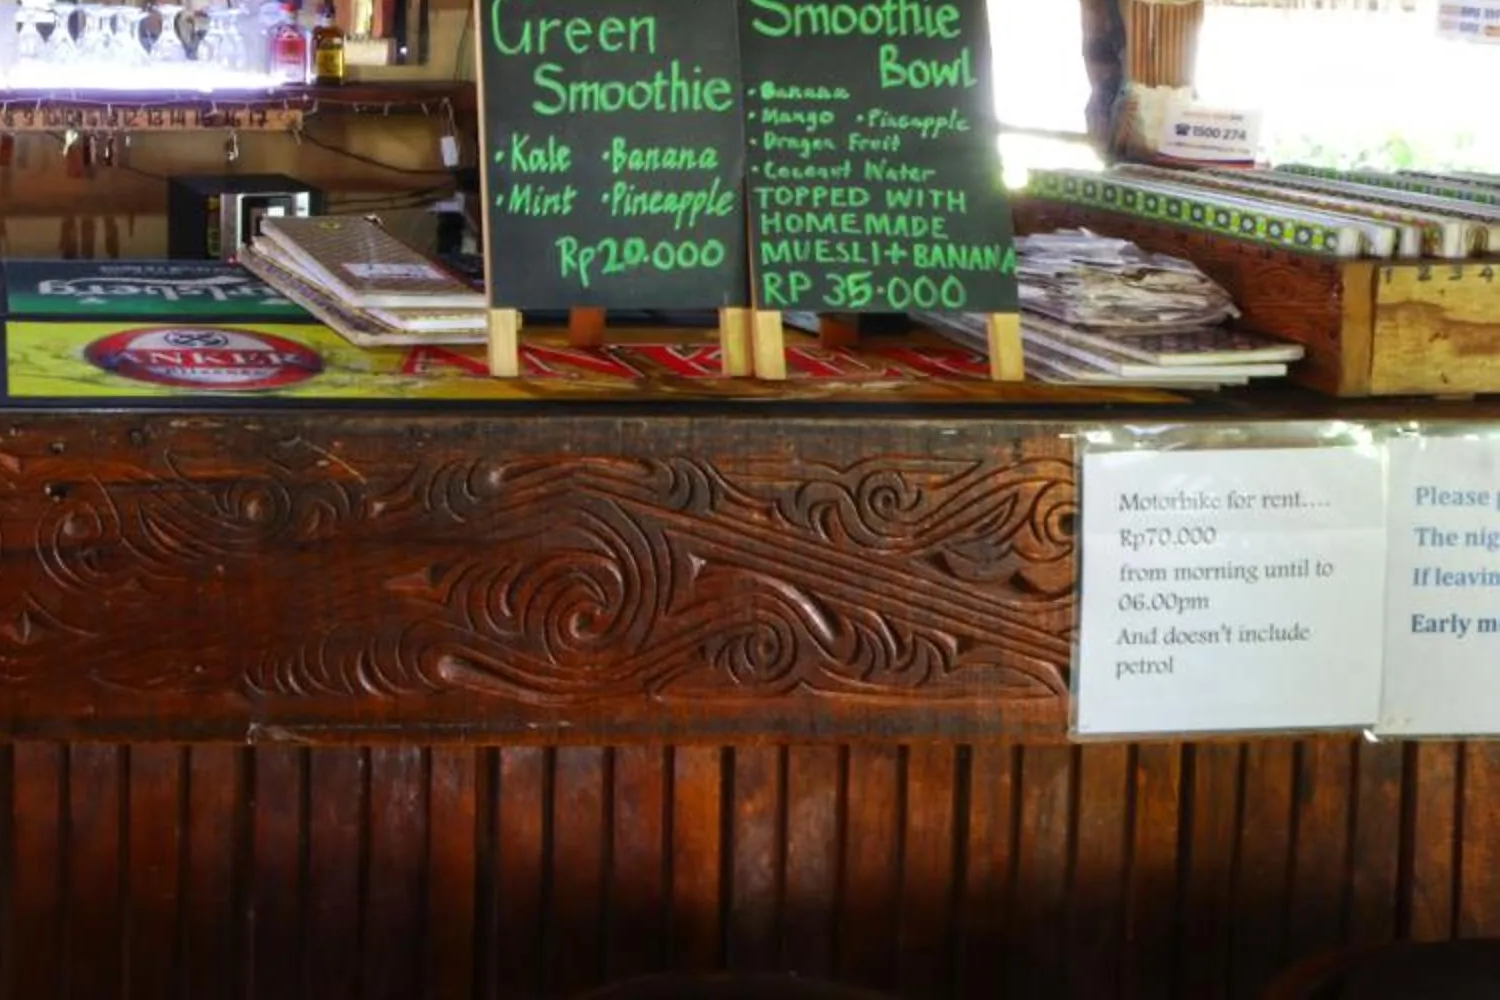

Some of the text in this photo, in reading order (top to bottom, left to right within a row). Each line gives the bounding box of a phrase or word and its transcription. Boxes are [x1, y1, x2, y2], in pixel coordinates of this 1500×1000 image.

[879, 43, 978, 90] Bowl
[532, 59, 735, 116] Smoothie
[760, 80, 850, 100] Banana
[761, 107, 970, 140] Mango Pineapple
[511, 132, 572, 174] Kale
[848, 131, 902, 152] Fruit
[612, 136, 719, 175] Banana
[508, 183, 578, 217] Mint
[611, 176, 736, 231] Pineapple
[753, 185, 968, 215] TOPPED WITH
[760, 212, 949, 240] HOMEMADE
[762, 270, 813, 306] RP
[102, 349, 303, 366] ANKER
[1118, 490, 1222, 512] Motorbike
[1226, 490, 1257, 510] for
[1415, 486, 1490, 507] Please
[1119, 526, 1217, 551] Rp70.000
[1413, 526, 1459, 547] The
[1119, 558, 1335, 584] from morning until to
[1412, 567, 1431, 587] If
[1118, 592, 1210, 615] 06.00pm
[1116, 621, 1311, 646] And doesn't include
[1411, 612, 1472, 639] Early
[1116, 656, 1174, 681] petrol
